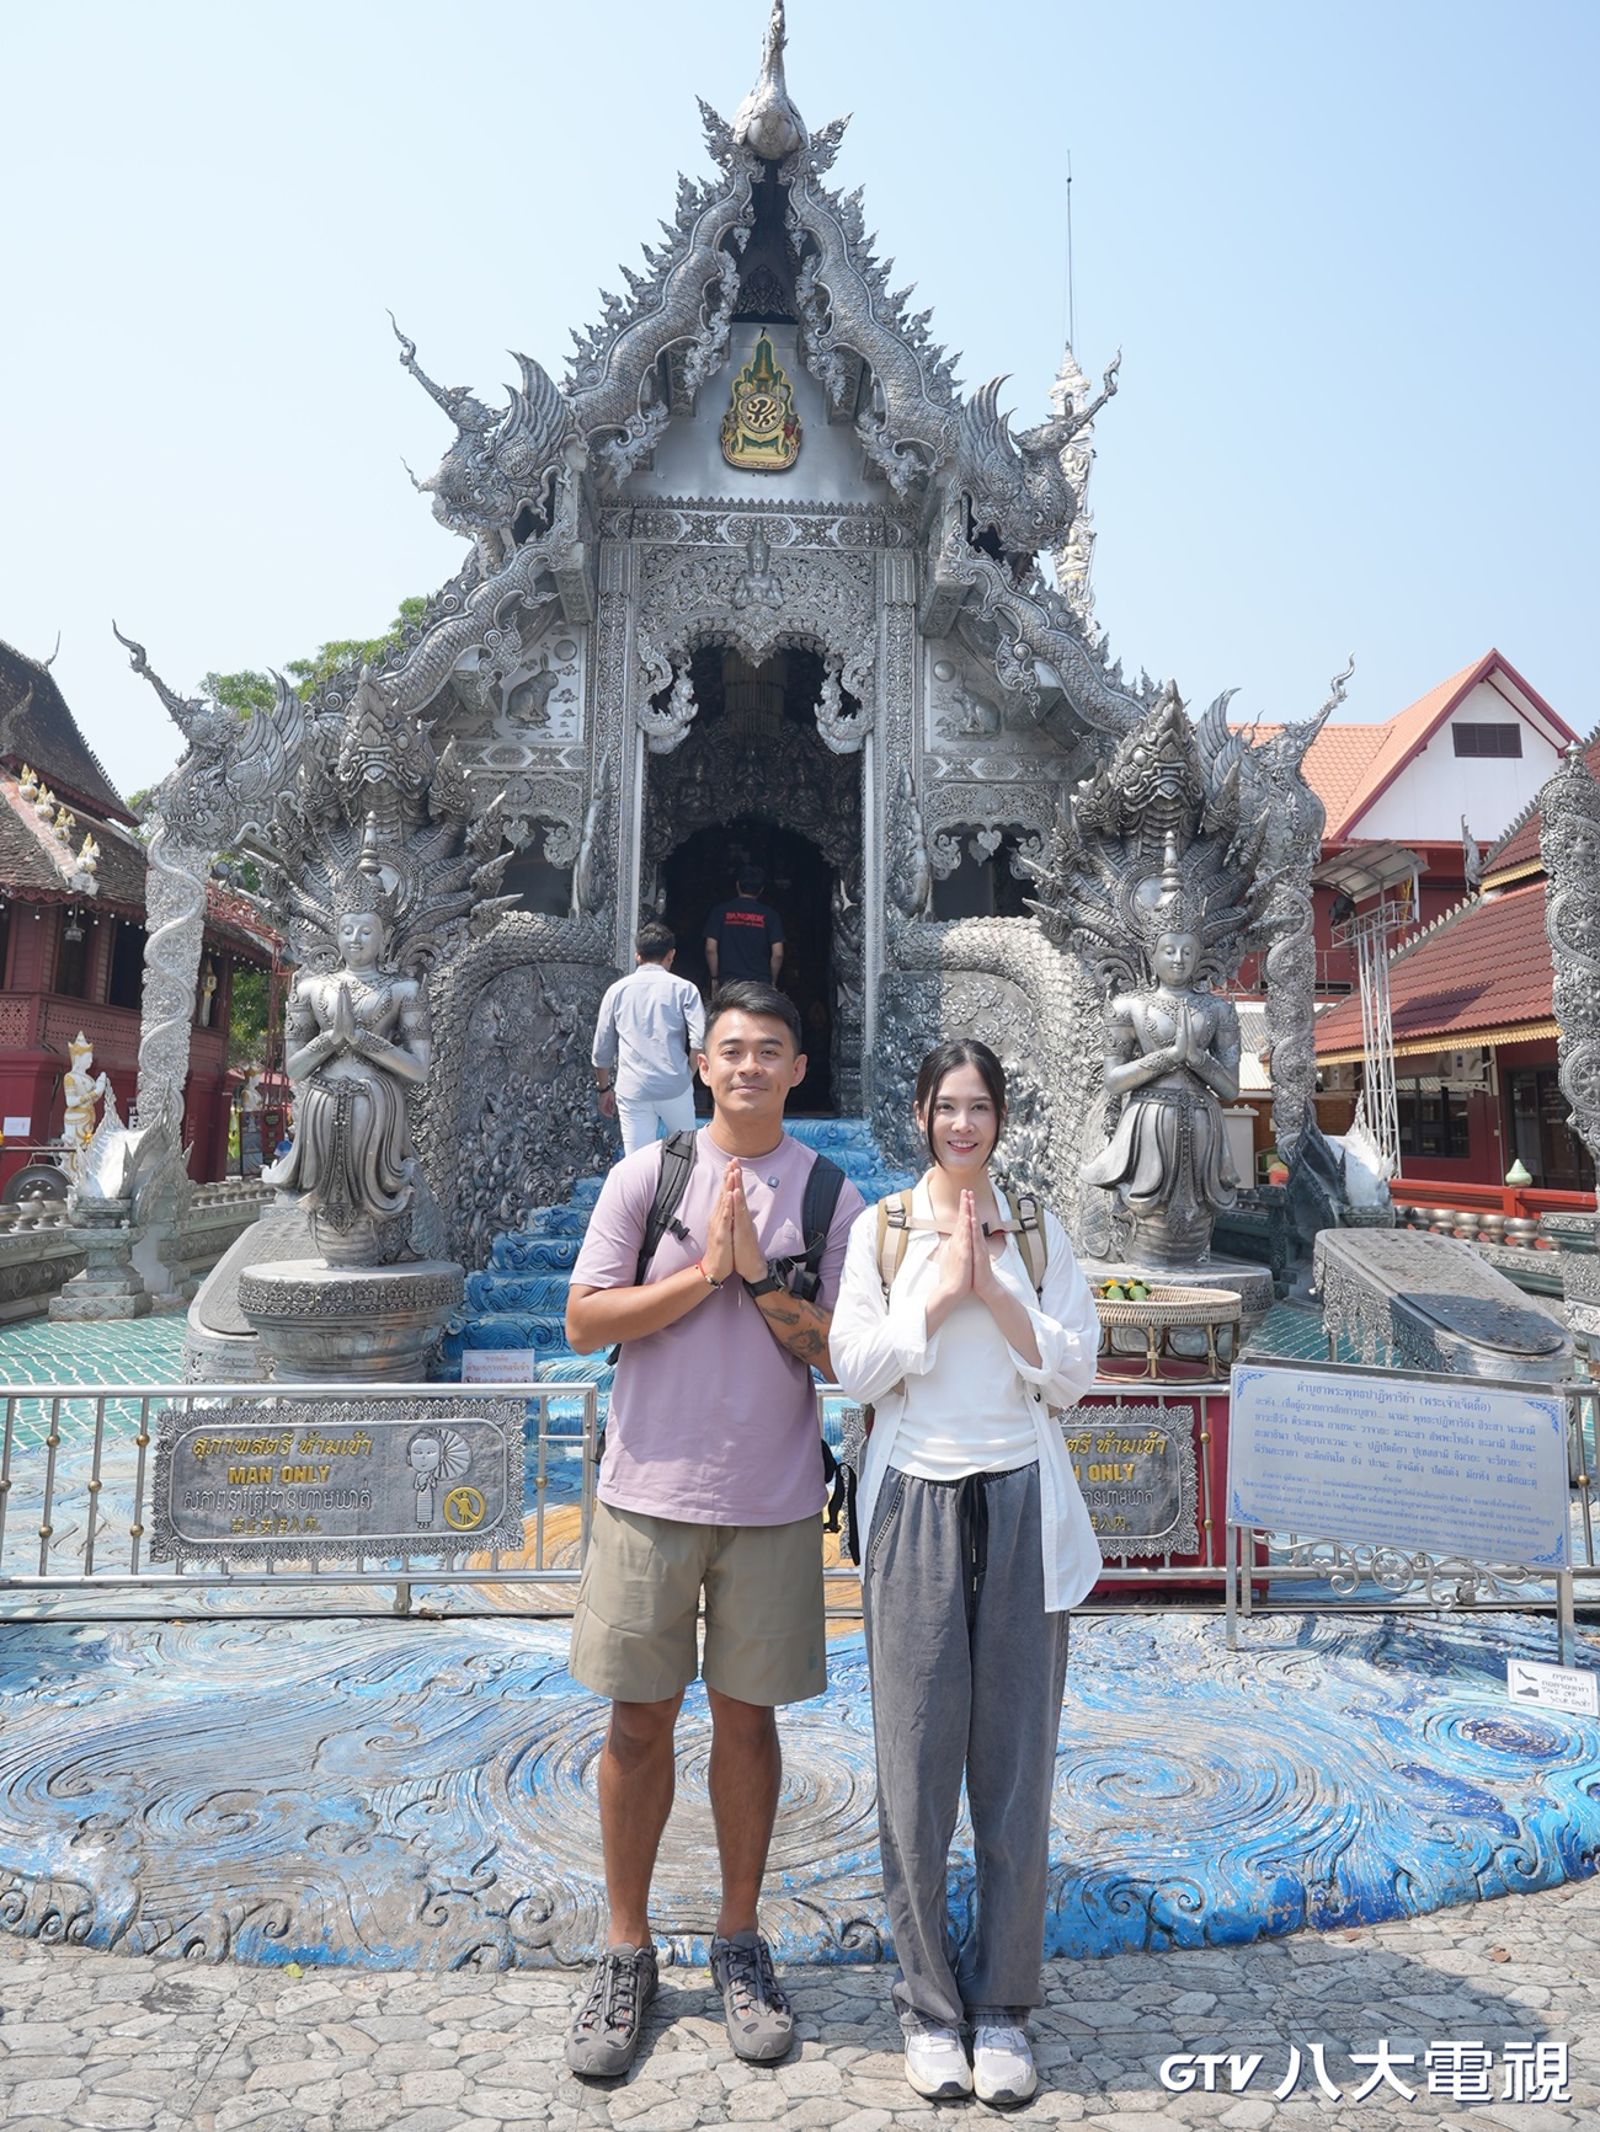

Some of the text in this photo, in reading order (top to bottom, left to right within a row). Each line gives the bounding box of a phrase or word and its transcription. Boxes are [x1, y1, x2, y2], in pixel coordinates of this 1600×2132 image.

[193, 1430, 373, 1462] สุภาพสตรี ห้ามเข้า
[1096, 1429, 1168, 1455] ห้ามเข้า
[228, 1465, 331, 1484] MAN ONLY
[1088, 1463, 1136, 1482] ONLY
